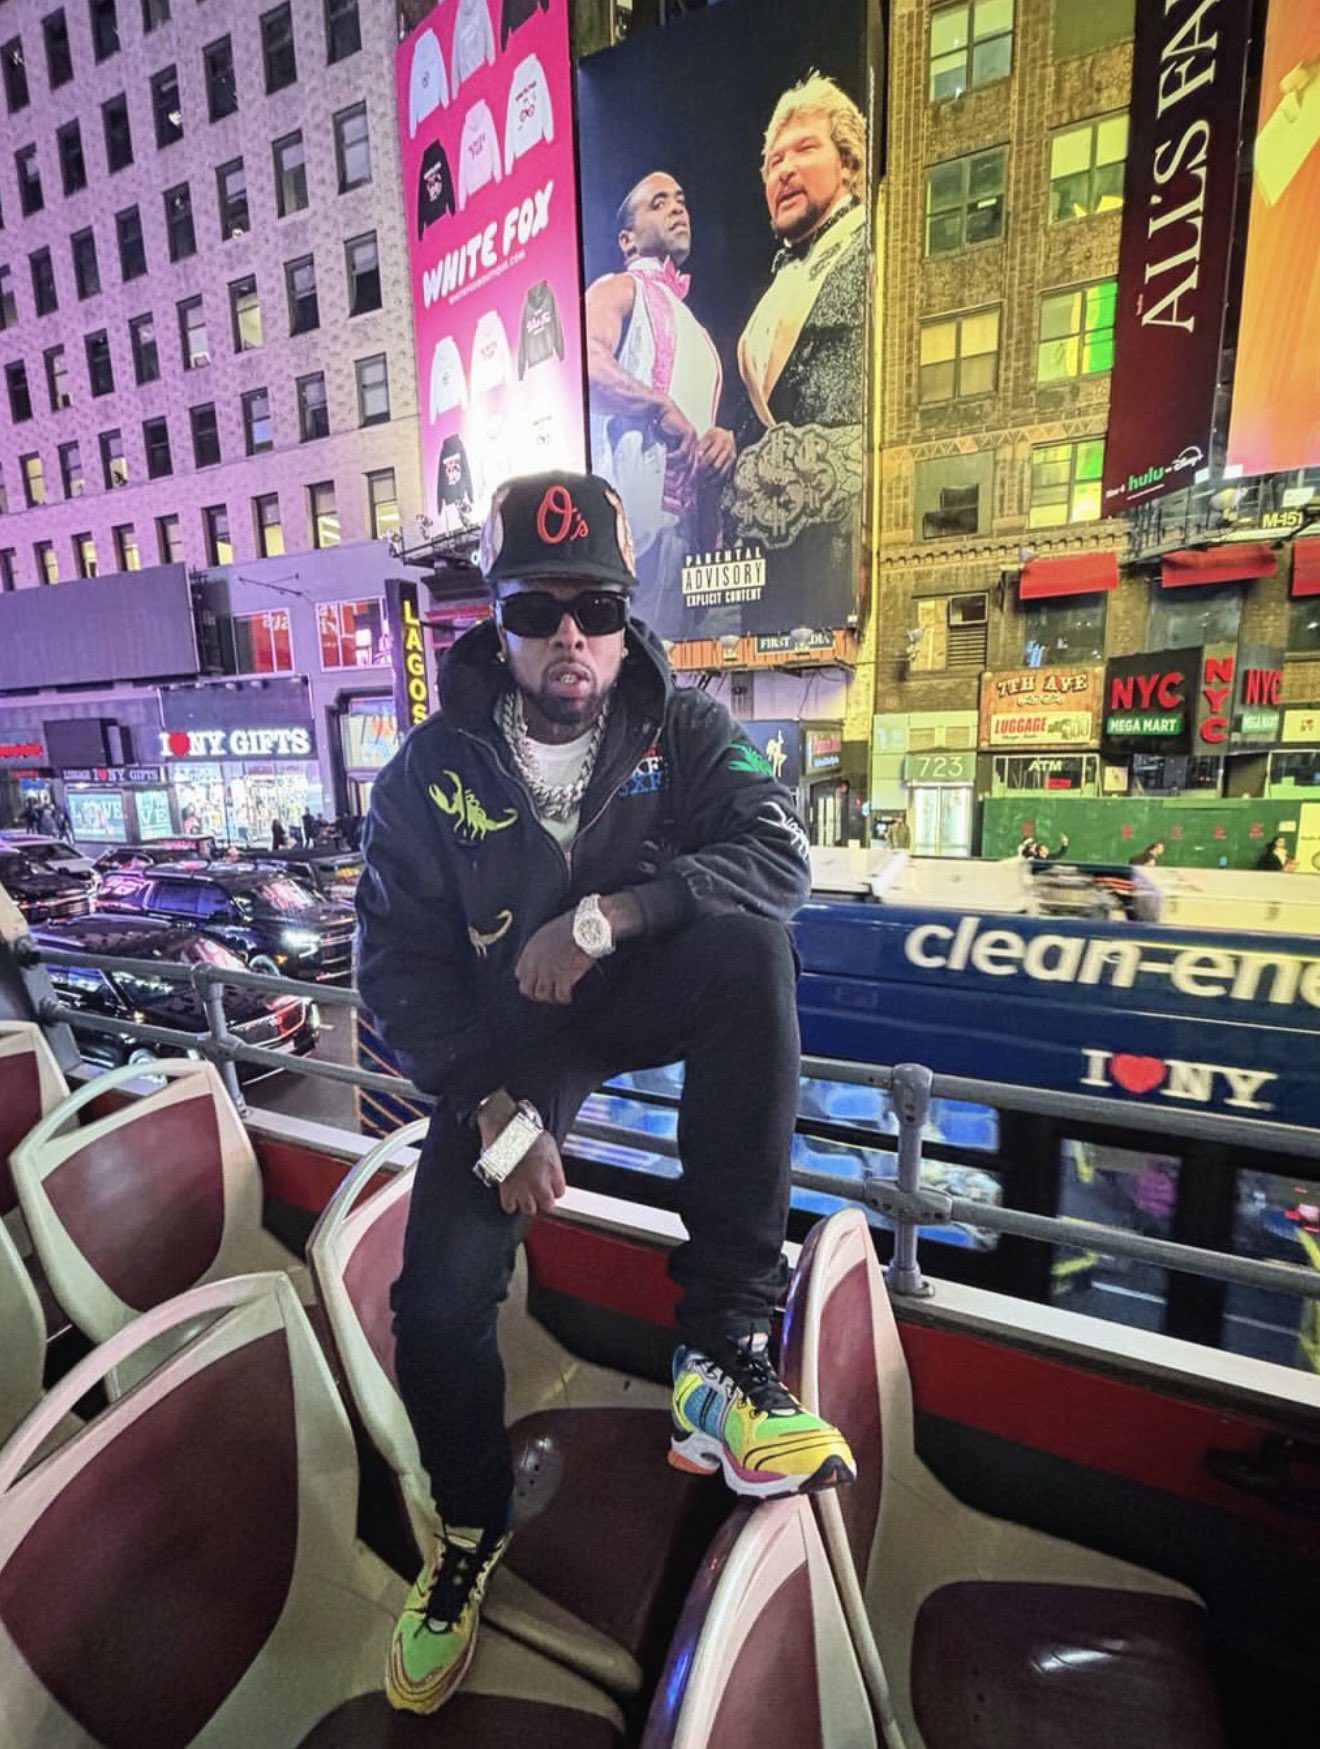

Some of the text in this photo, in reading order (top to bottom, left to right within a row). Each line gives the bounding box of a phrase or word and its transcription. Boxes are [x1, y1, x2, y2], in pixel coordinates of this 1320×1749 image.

[1142, 0, 1219, 332] ALL'S FA
[423, 220, 498, 309] WHITE
[502, 179, 554, 257] FOX
[1127, 465, 1165, 492] hulu
[536, 485, 588, 544] O's
[686, 546, 762, 567] PARENTAL
[685, 561, 762, 591] ADVISORY
[686, 587, 762, 608] EXPLICIT CONTENT
[760, 636, 791, 650] FIRST
[403, 600, 427, 725] LAGOS
[998, 674, 1088, 698] 7TH AVE
[1110, 671, 1184, 710] NYC
[1200, 655, 1234, 743] NYC
[1244, 669, 1283, 705] NYC
[994, 717, 1046, 734] LUGGAGE
[1111, 717, 1177, 732] MEGA MART
[187, 730, 227, 756] NY
[229, 727, 312, 755] GIFTS
[919, 756, 963, 778] 723
[1028, 760, 1062, 772] ATM
[1080, 1048, 1280, 1111] I NY
